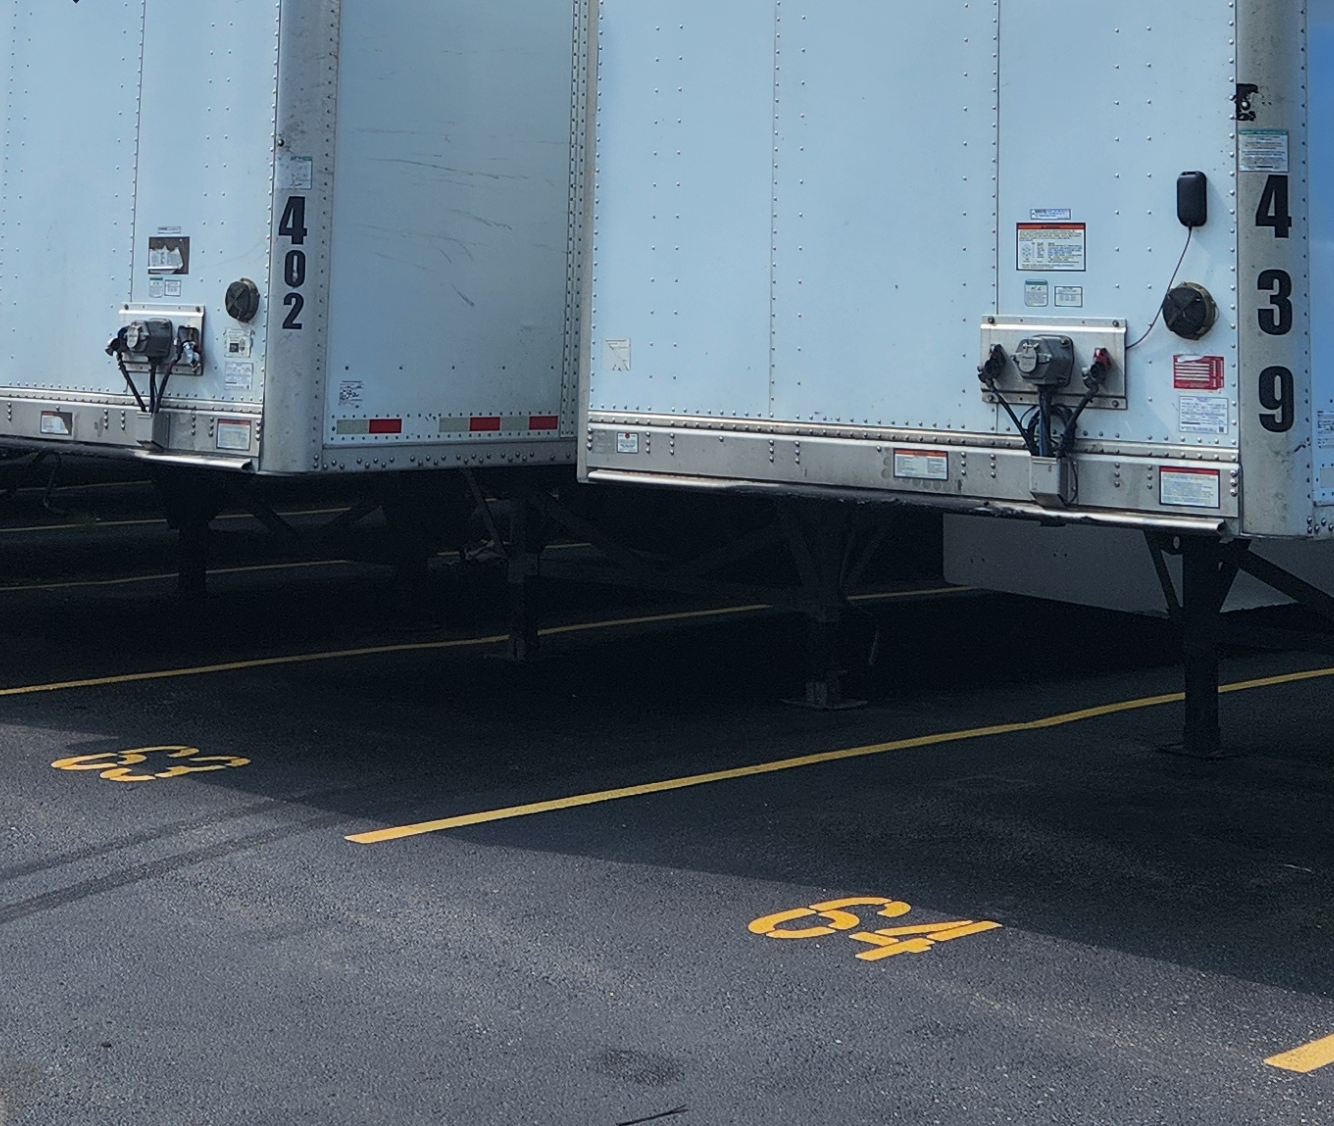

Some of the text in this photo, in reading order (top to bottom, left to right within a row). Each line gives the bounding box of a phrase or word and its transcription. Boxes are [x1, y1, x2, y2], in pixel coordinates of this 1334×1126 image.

[278, 195, 307, 330] 402
[1255, 174, 1295, 433] 439
[50, 745, 251, 782] 63
[747, 895, 1003, 961] 64
